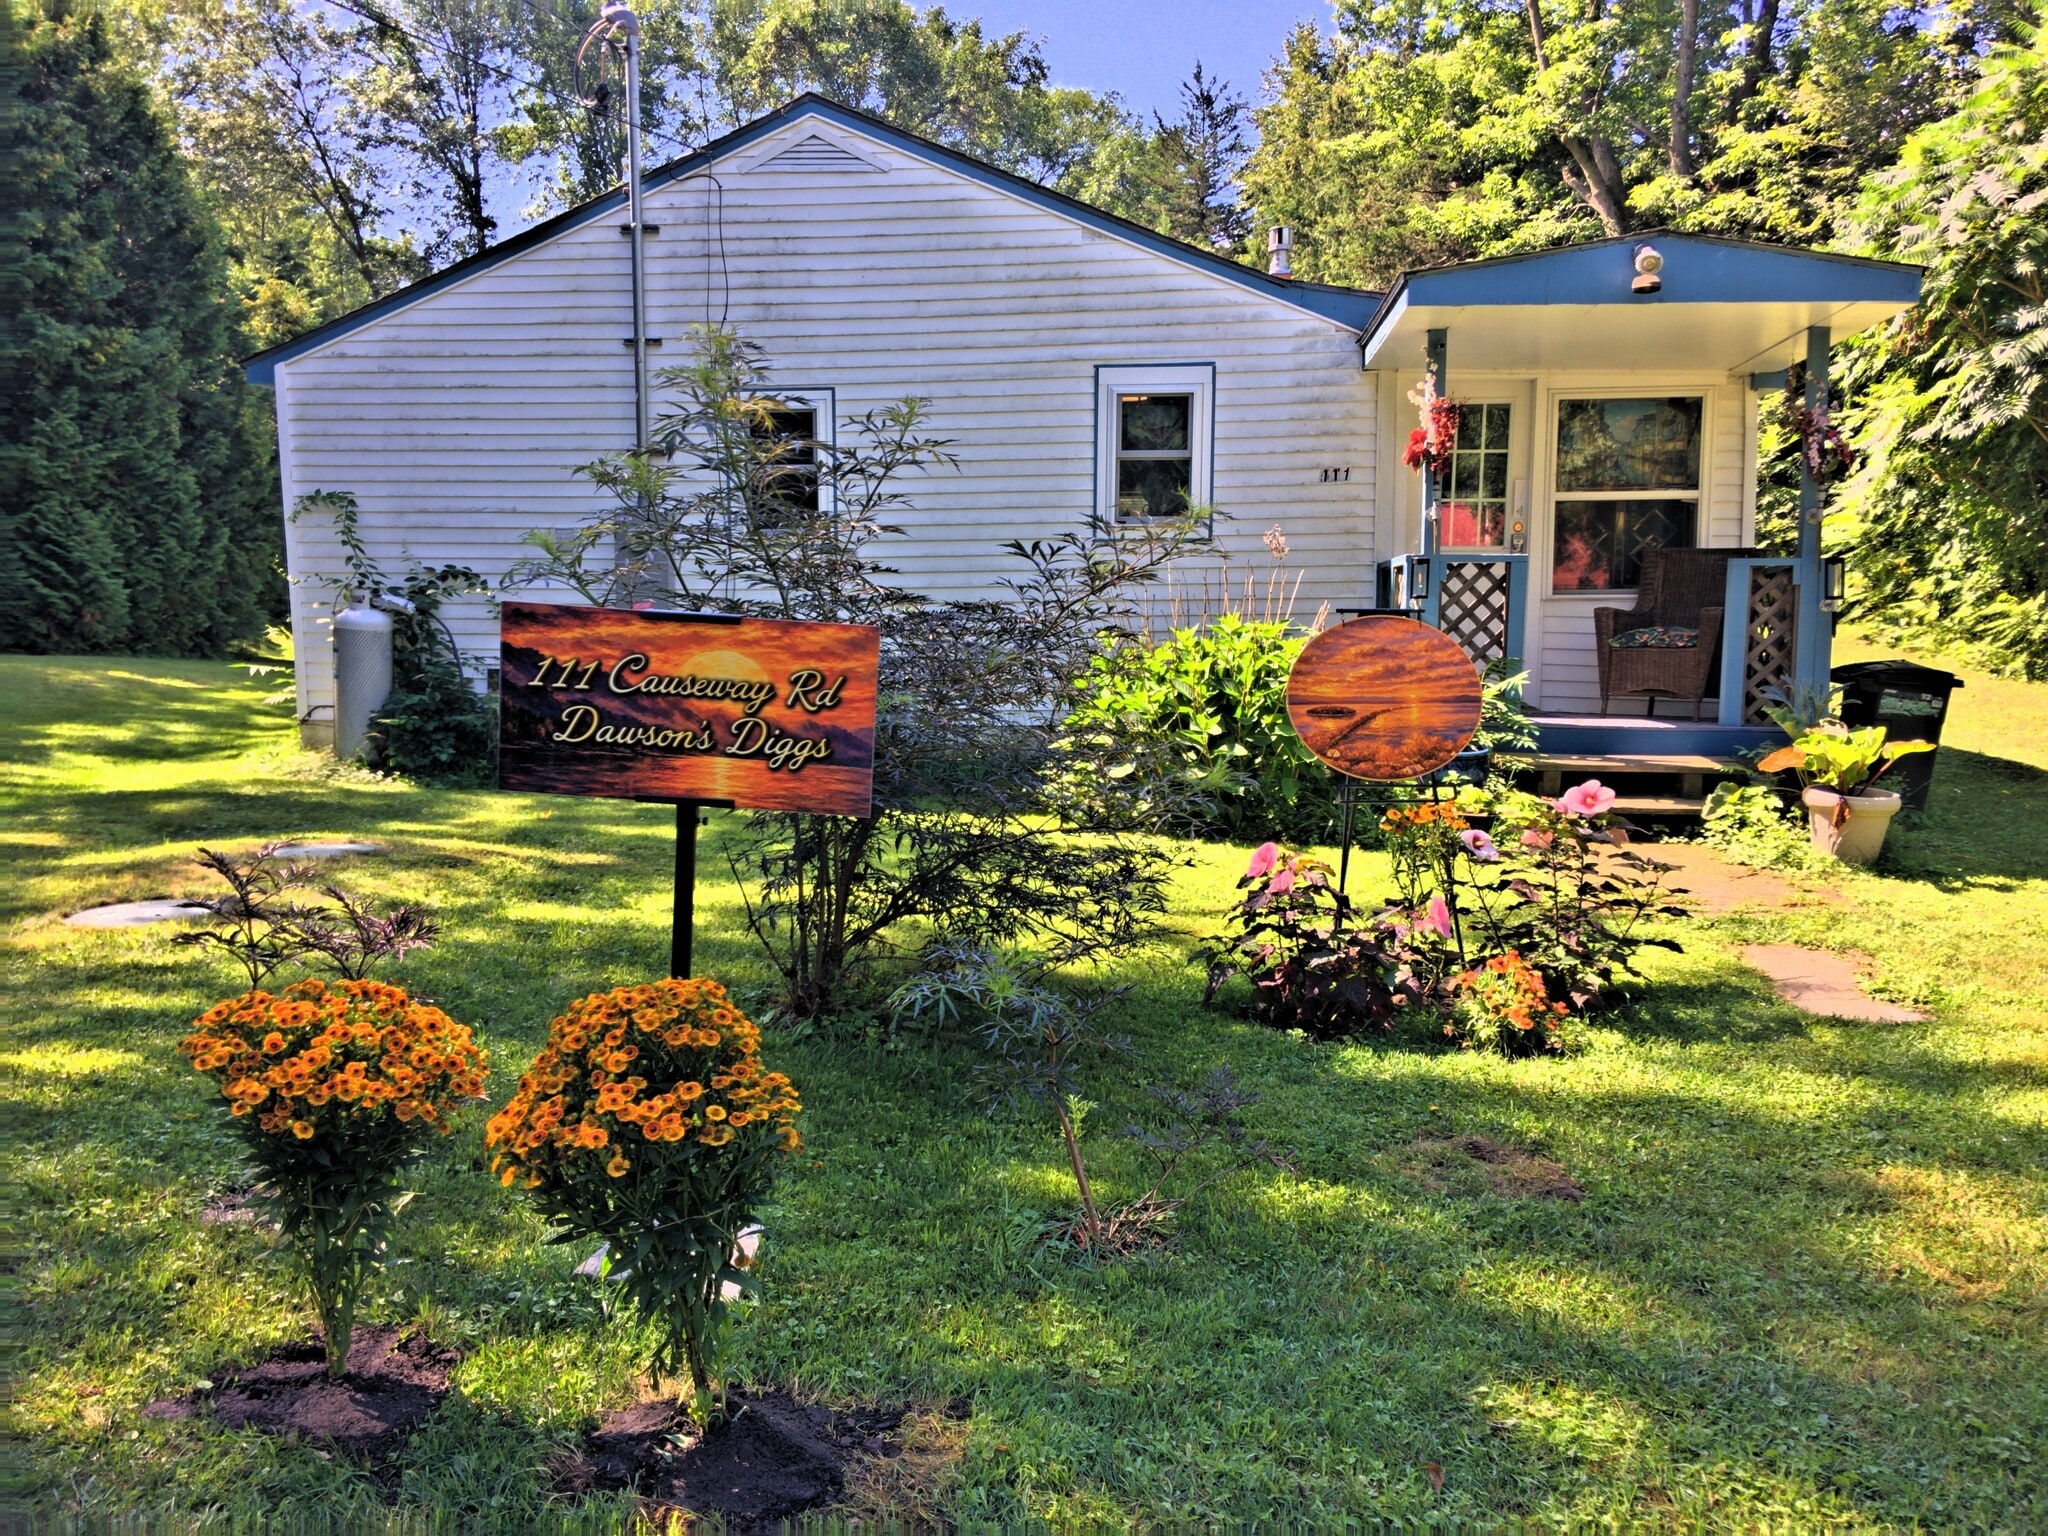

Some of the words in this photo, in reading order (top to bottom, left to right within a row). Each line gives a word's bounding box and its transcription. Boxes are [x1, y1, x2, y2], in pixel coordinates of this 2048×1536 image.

[1322, 467, 1350, 482] 111
[528, 657, 600, 690] 111
[609, 654, 776, 713] Causeway
[787, 670, 846, 711] Rd
[552, 705, 714, 749] Dawson's
[725, 717, 831, 769] Diggs
